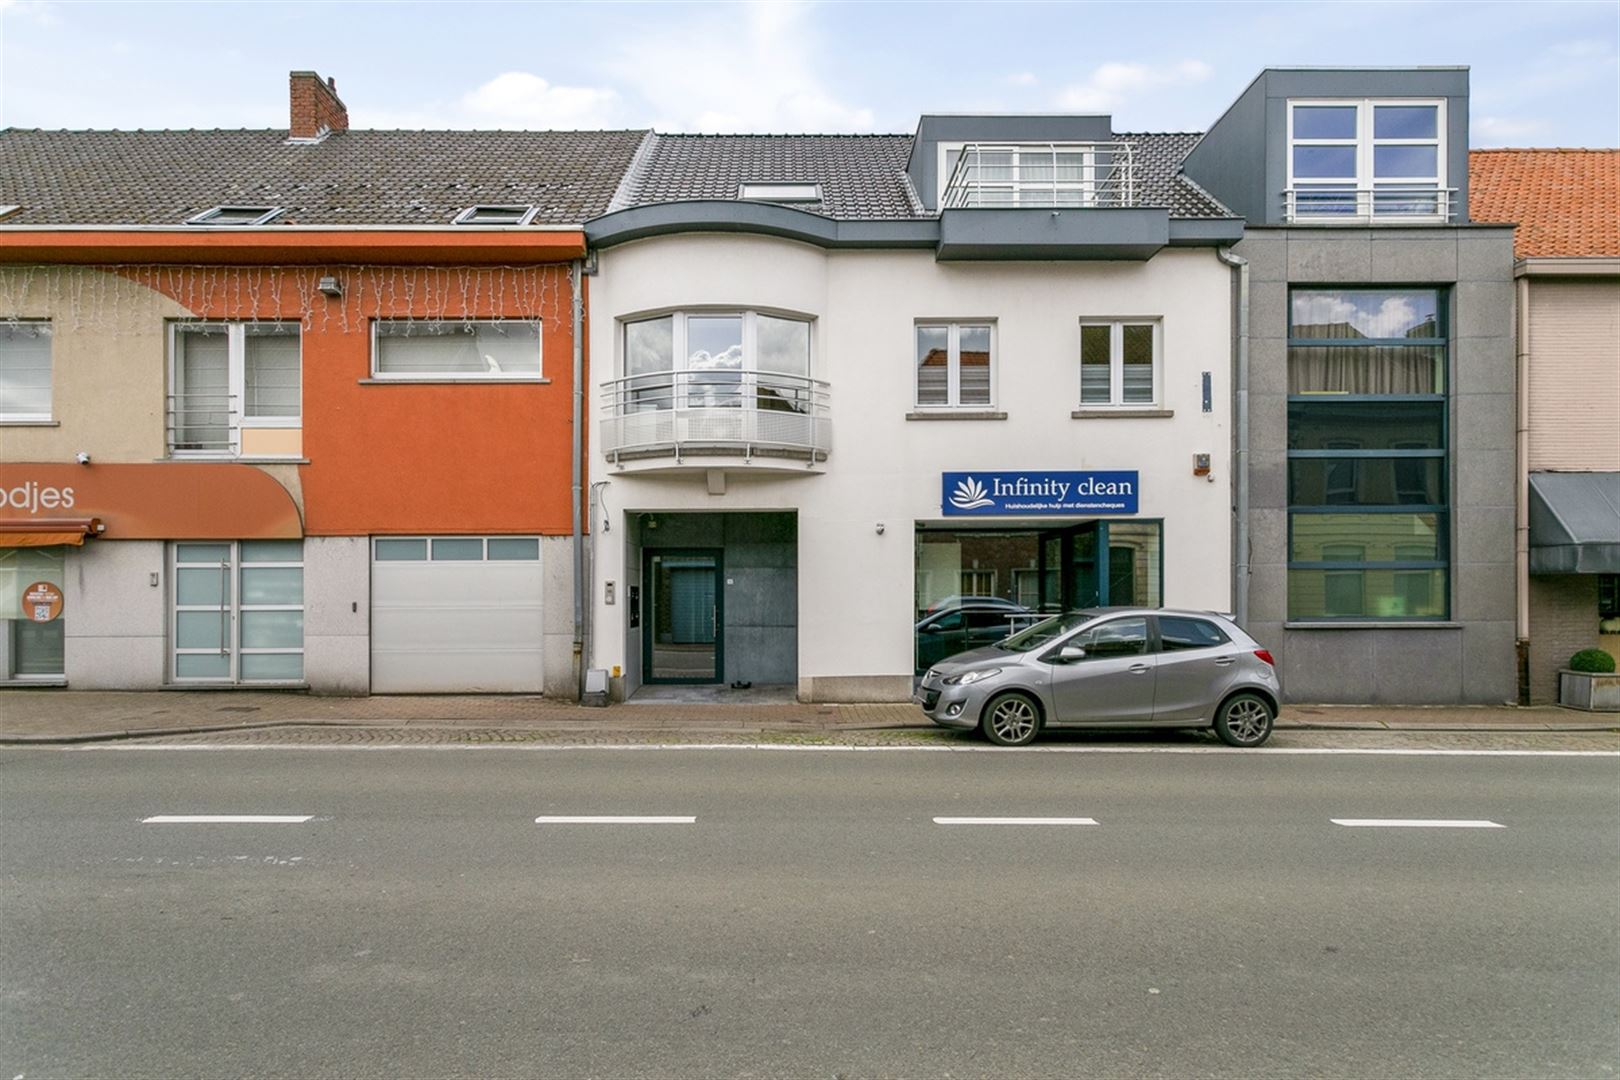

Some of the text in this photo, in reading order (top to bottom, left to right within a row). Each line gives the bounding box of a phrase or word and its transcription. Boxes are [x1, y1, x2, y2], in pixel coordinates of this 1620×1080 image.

[993, 477, 1132, 502] Infinity clean
[1048, 502, 1062, 510] hulp
